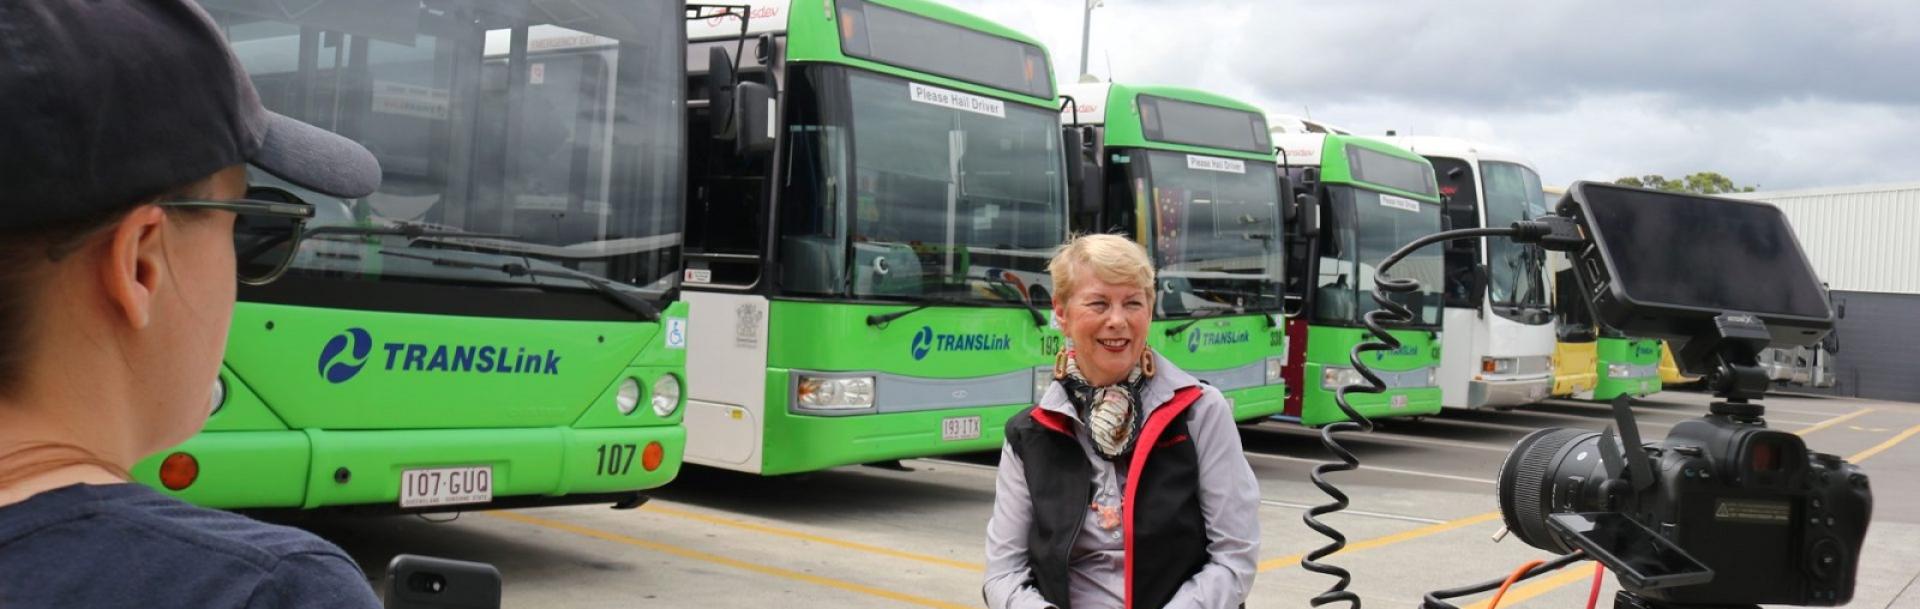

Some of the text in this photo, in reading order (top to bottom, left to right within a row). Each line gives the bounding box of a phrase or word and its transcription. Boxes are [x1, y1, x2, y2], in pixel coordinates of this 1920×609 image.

[916, 87, 999, 114] Please Hail Driver
[1190, 156, 1212, 168] Please
[936, 333, 1011, 351] TRANSLink
[1040, 335, 1060, 356] 193
[1203, 330, 1249, 345] TRANSLink
[383, 342, 561, 375] TRANSLink
[597, 443, 637, 476] 107
